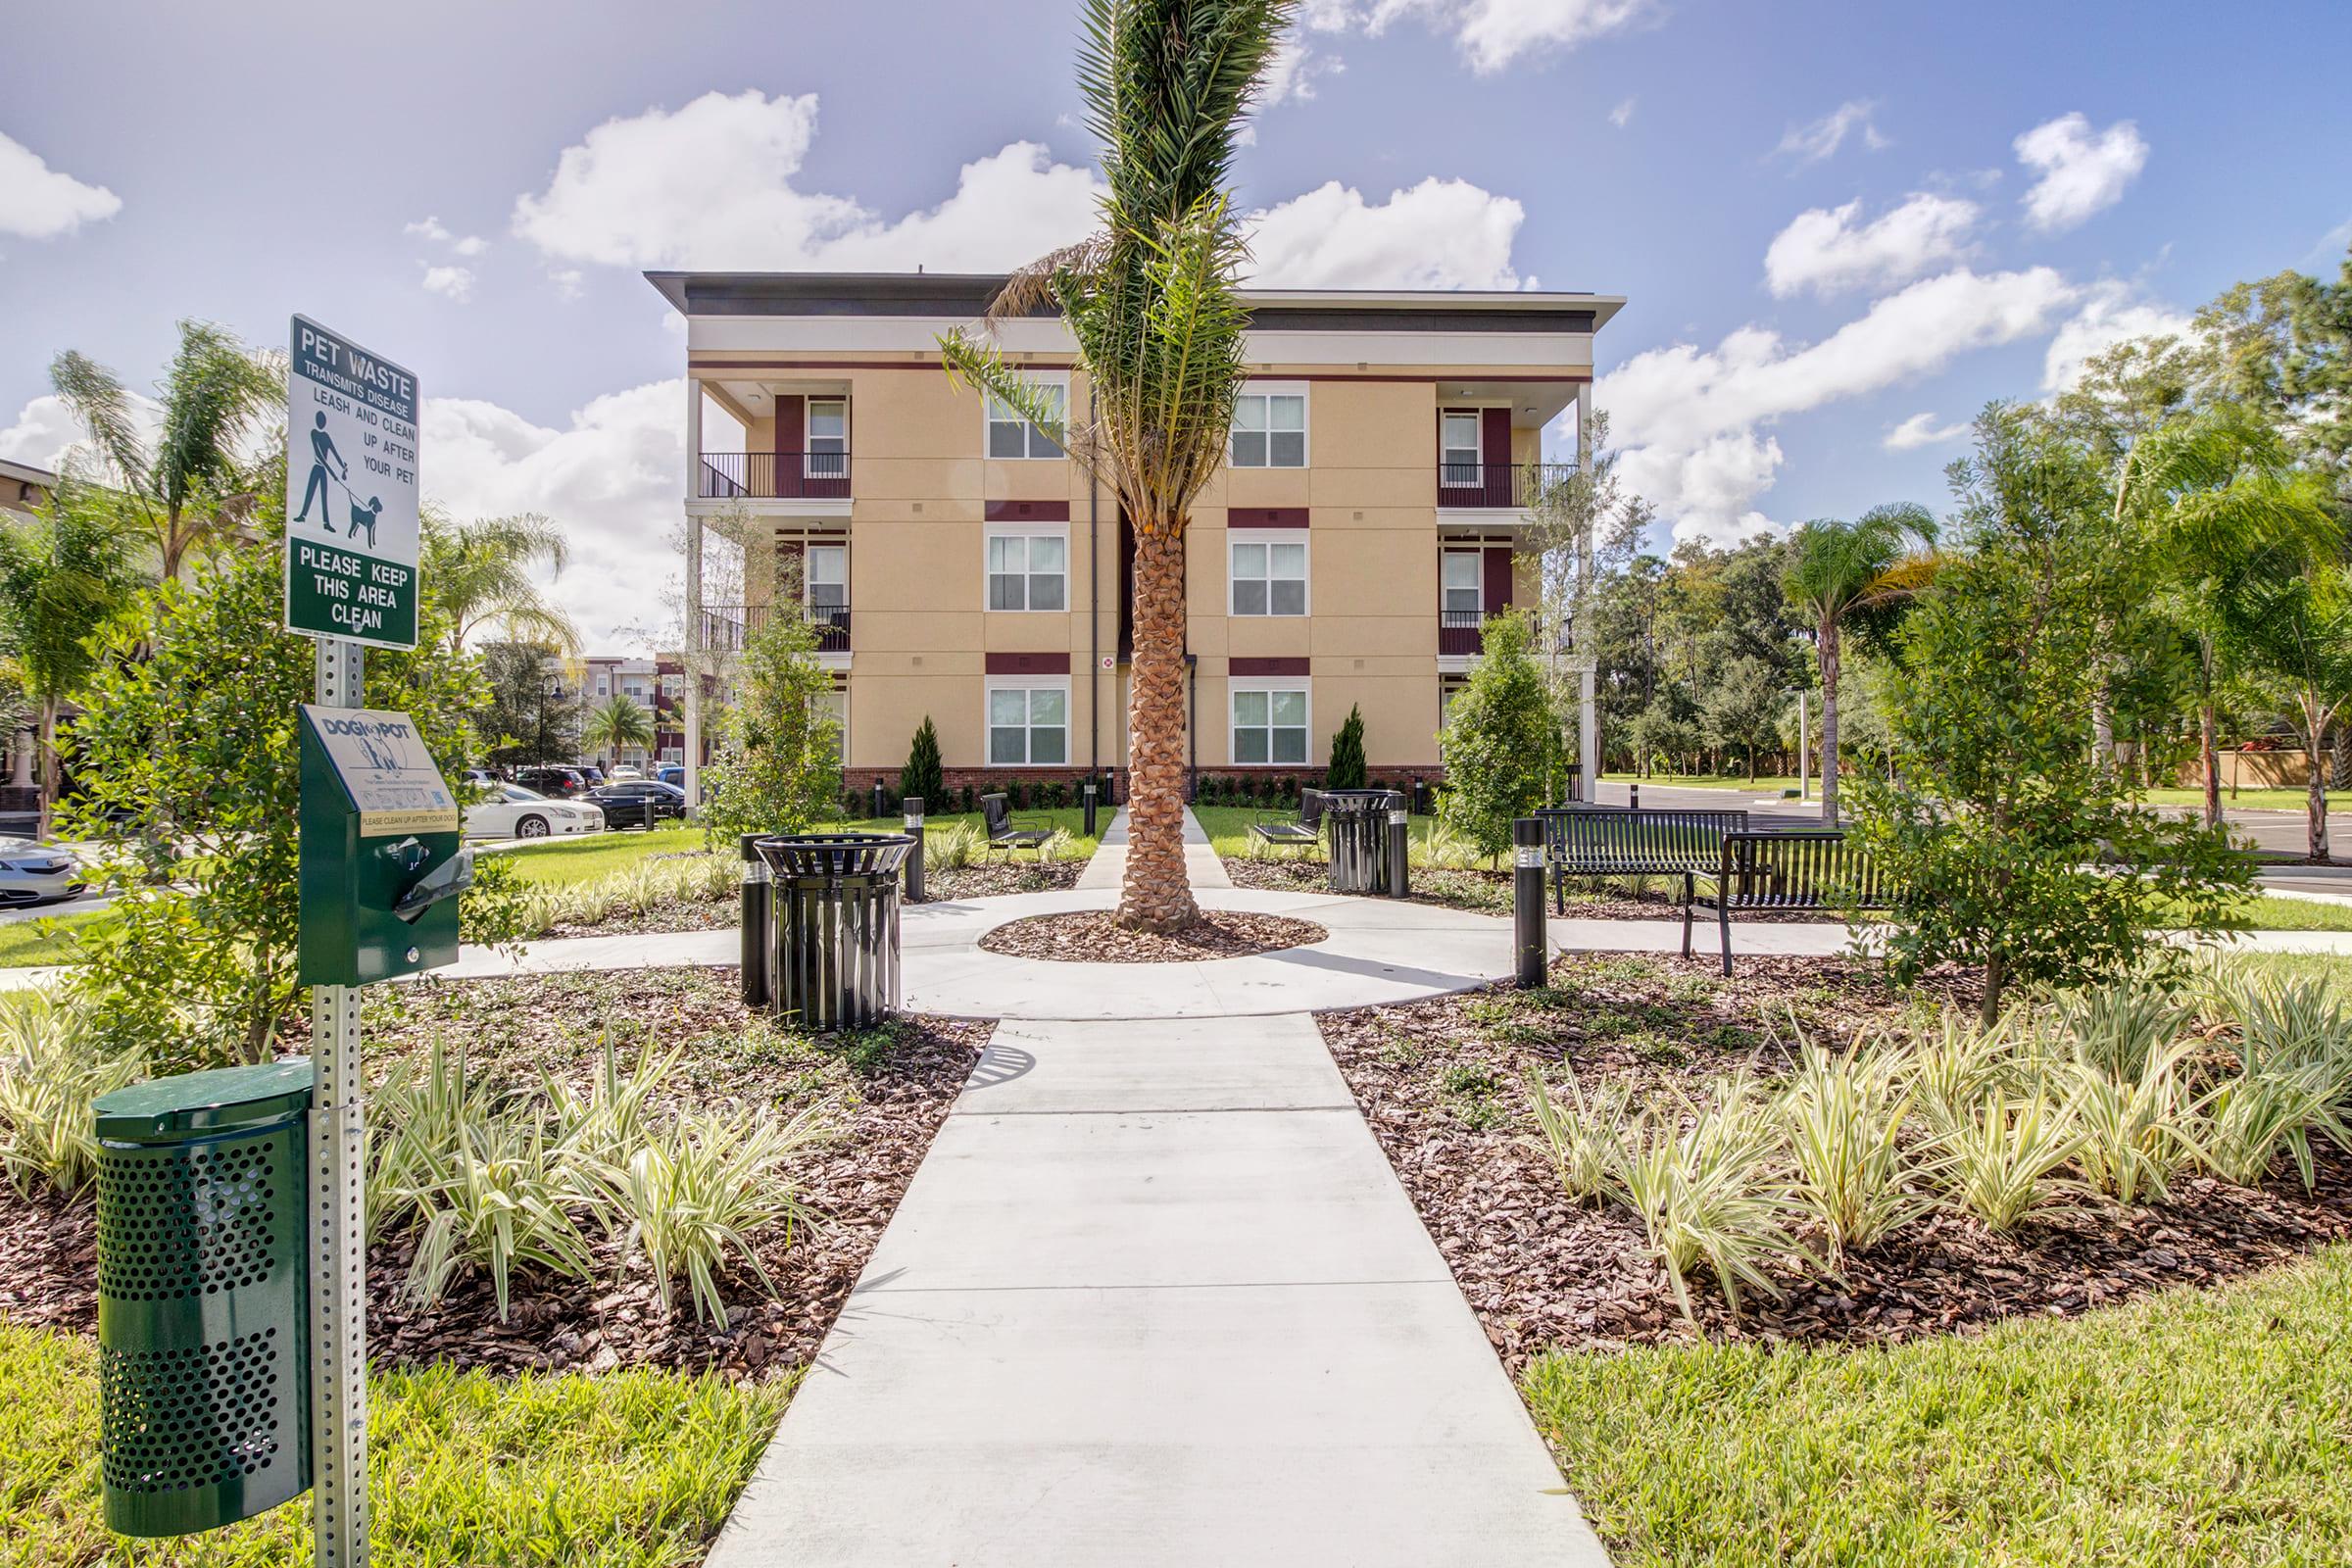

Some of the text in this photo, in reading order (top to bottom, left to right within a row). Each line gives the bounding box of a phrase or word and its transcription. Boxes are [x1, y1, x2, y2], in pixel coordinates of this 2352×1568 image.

[301, 327, 412, 401] PET WASTE
[305, 360, 409, 418] TRANSMITS DISEASE
[314, 387, 416, 442] LEASH AND CLEAN
[364, 431, 415, 464] UP AFTER
[364, 455, 415, 485] YOUR PET
[300, 546, 408, 588] PLEASE KEEP
[314, 574, 397, 609] THIS AREA
[331, 603, 382, 629] CLEAN
[363, 817, 383, 826] PLEASE
[383, 816, 403, 825] CLEAN
[404, 815, 411, 824] UP
